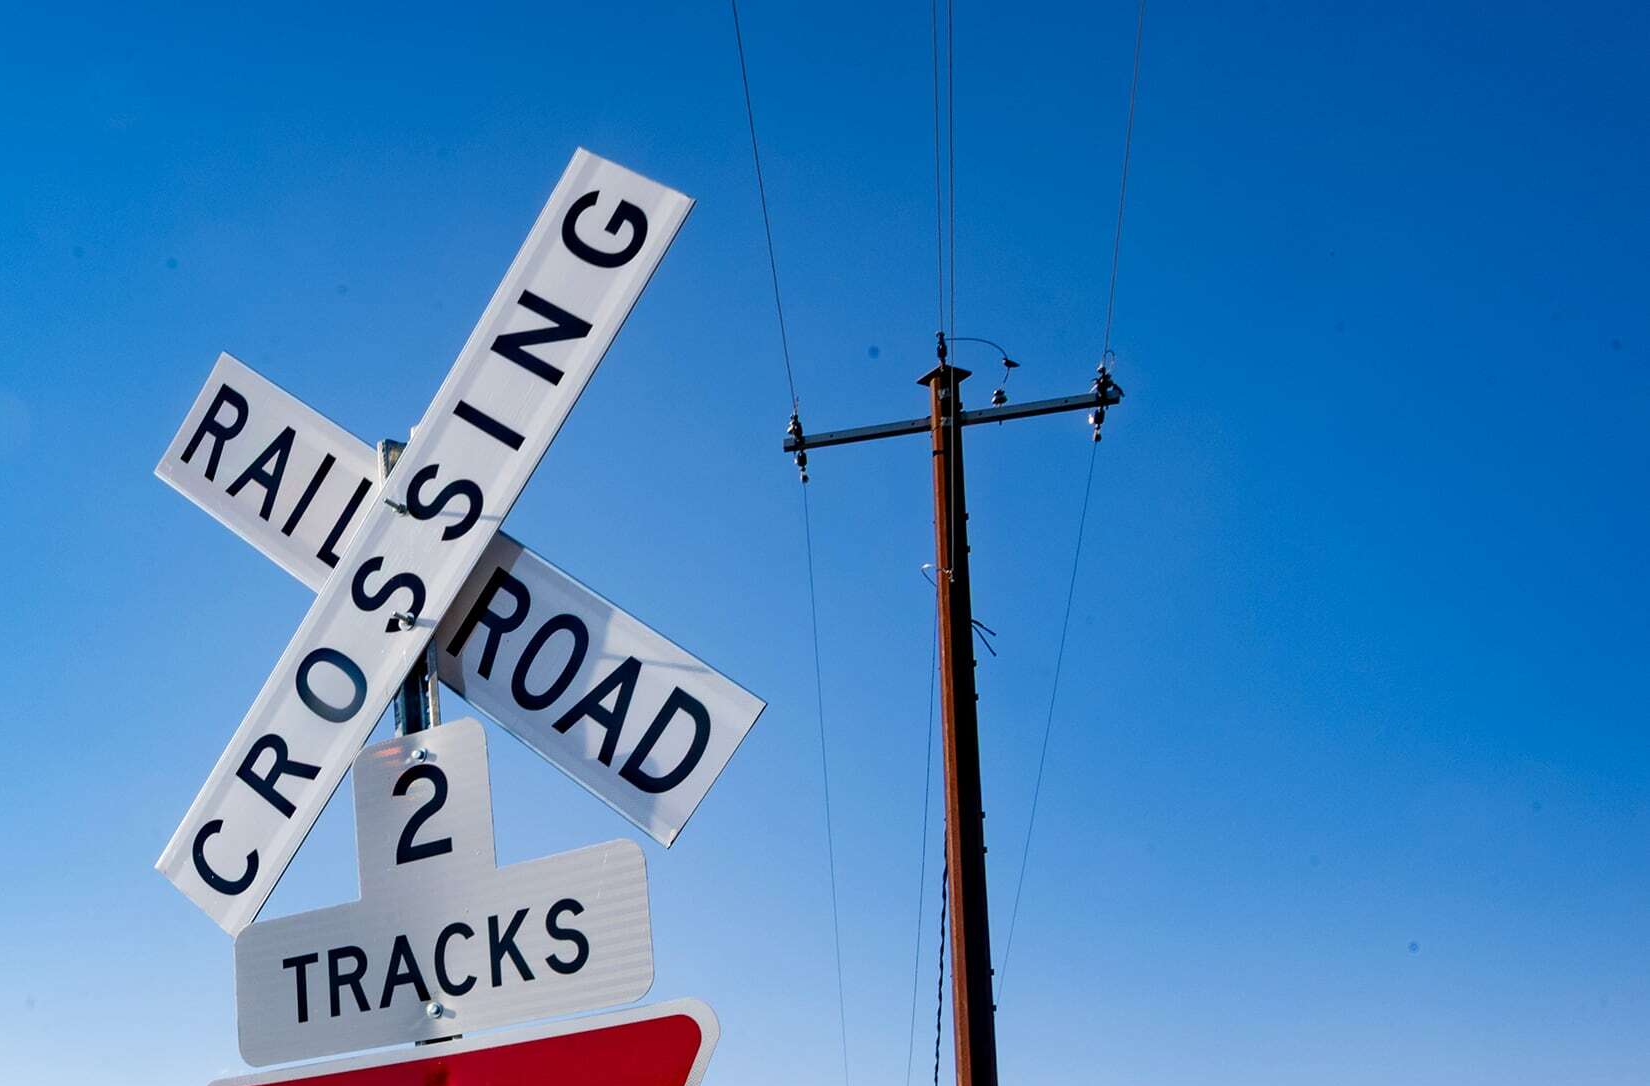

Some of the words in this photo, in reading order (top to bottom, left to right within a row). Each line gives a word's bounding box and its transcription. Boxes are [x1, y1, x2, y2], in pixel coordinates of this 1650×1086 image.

[180, 384, 372, 568] RAIL
[446, 567, 711, 794] ROAD
[193, 190, 648, 896] CROSSING
[392, 763, 453, 865] 2
[282, 898, 590, 1023] TRACKS
